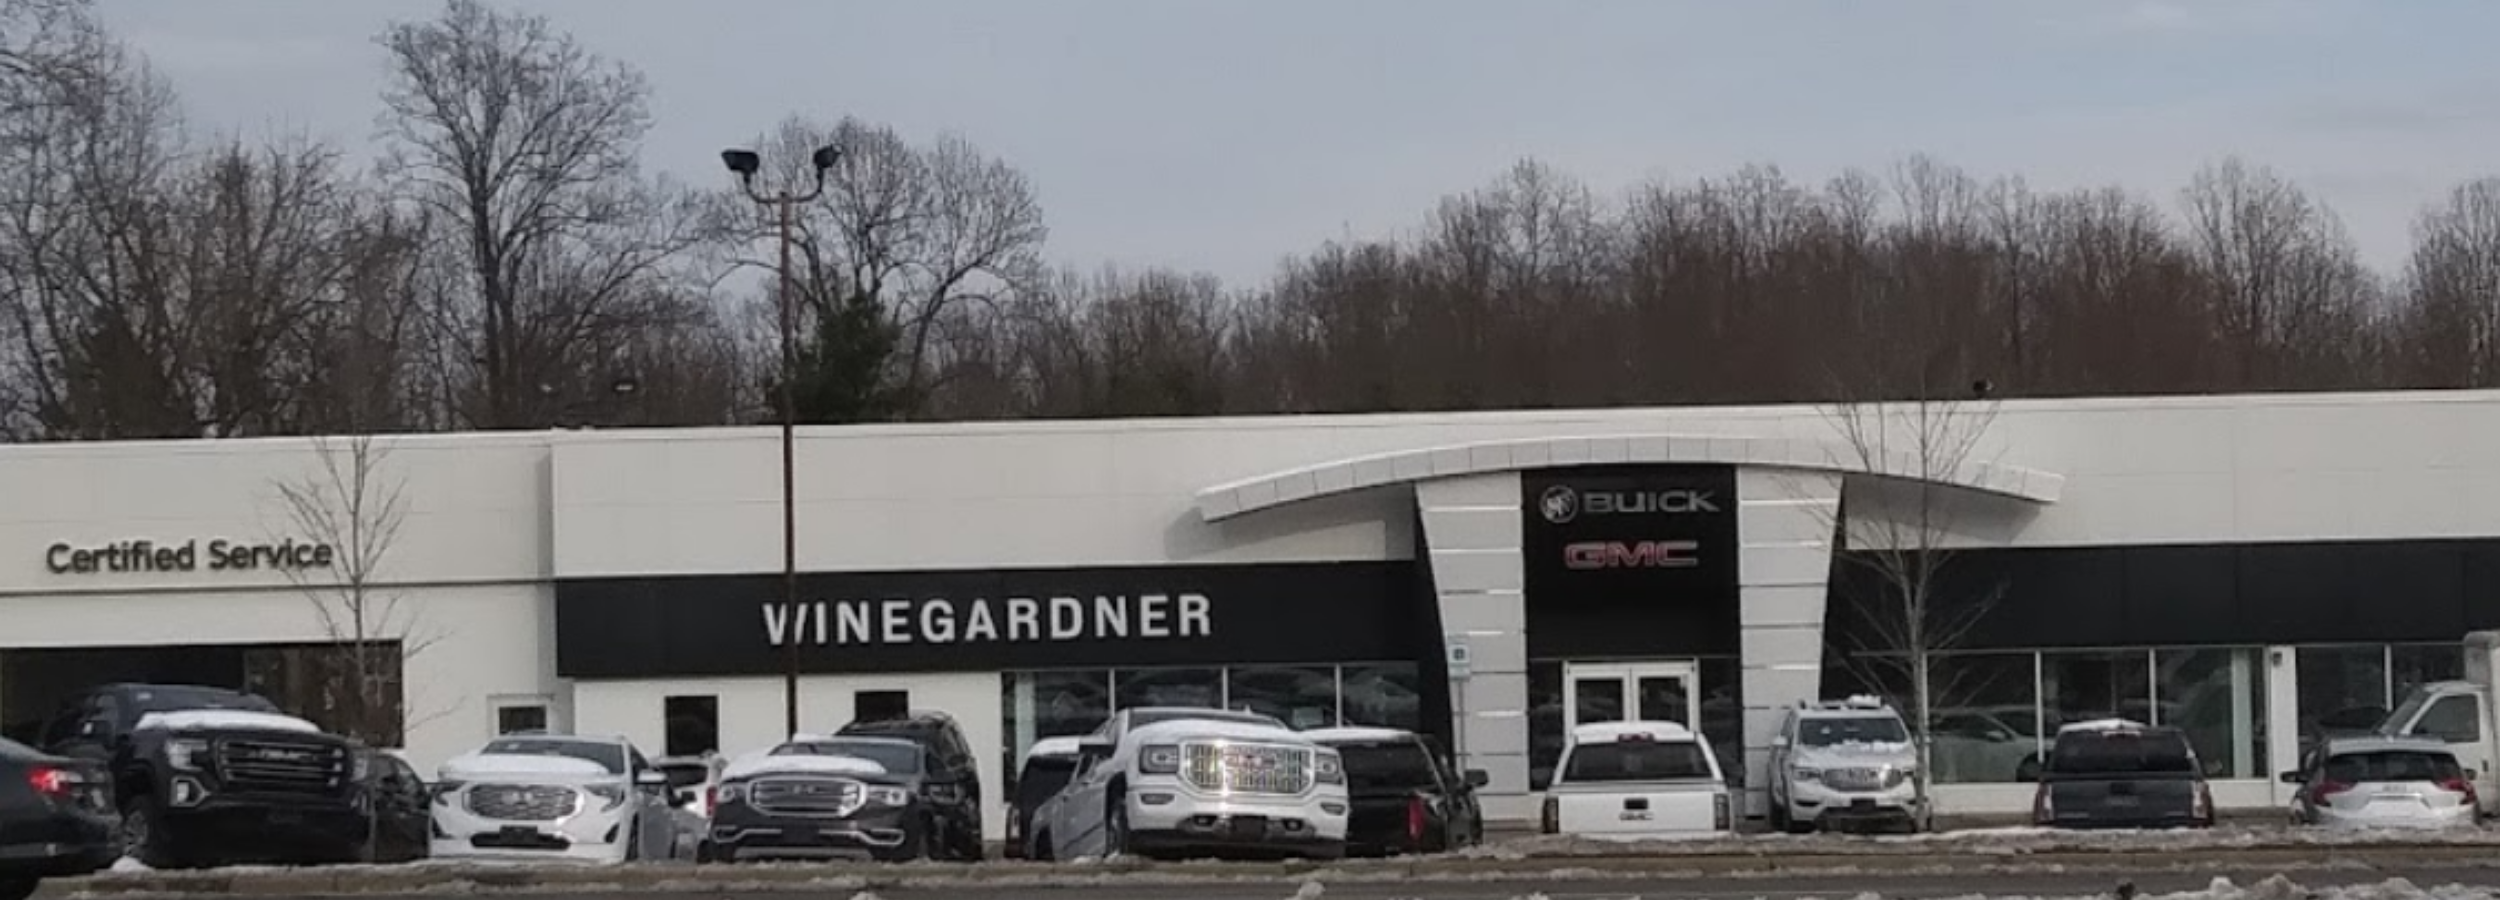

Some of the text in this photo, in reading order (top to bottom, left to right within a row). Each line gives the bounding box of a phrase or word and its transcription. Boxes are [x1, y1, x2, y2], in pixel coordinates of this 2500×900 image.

[1582, 490, 1720, 513] BUICK
[46, 537, 334, 574] Certified Service
[1564, 540, 1698, 570] GMC
[762, 594, 1212, 645] WINEGARDNER
